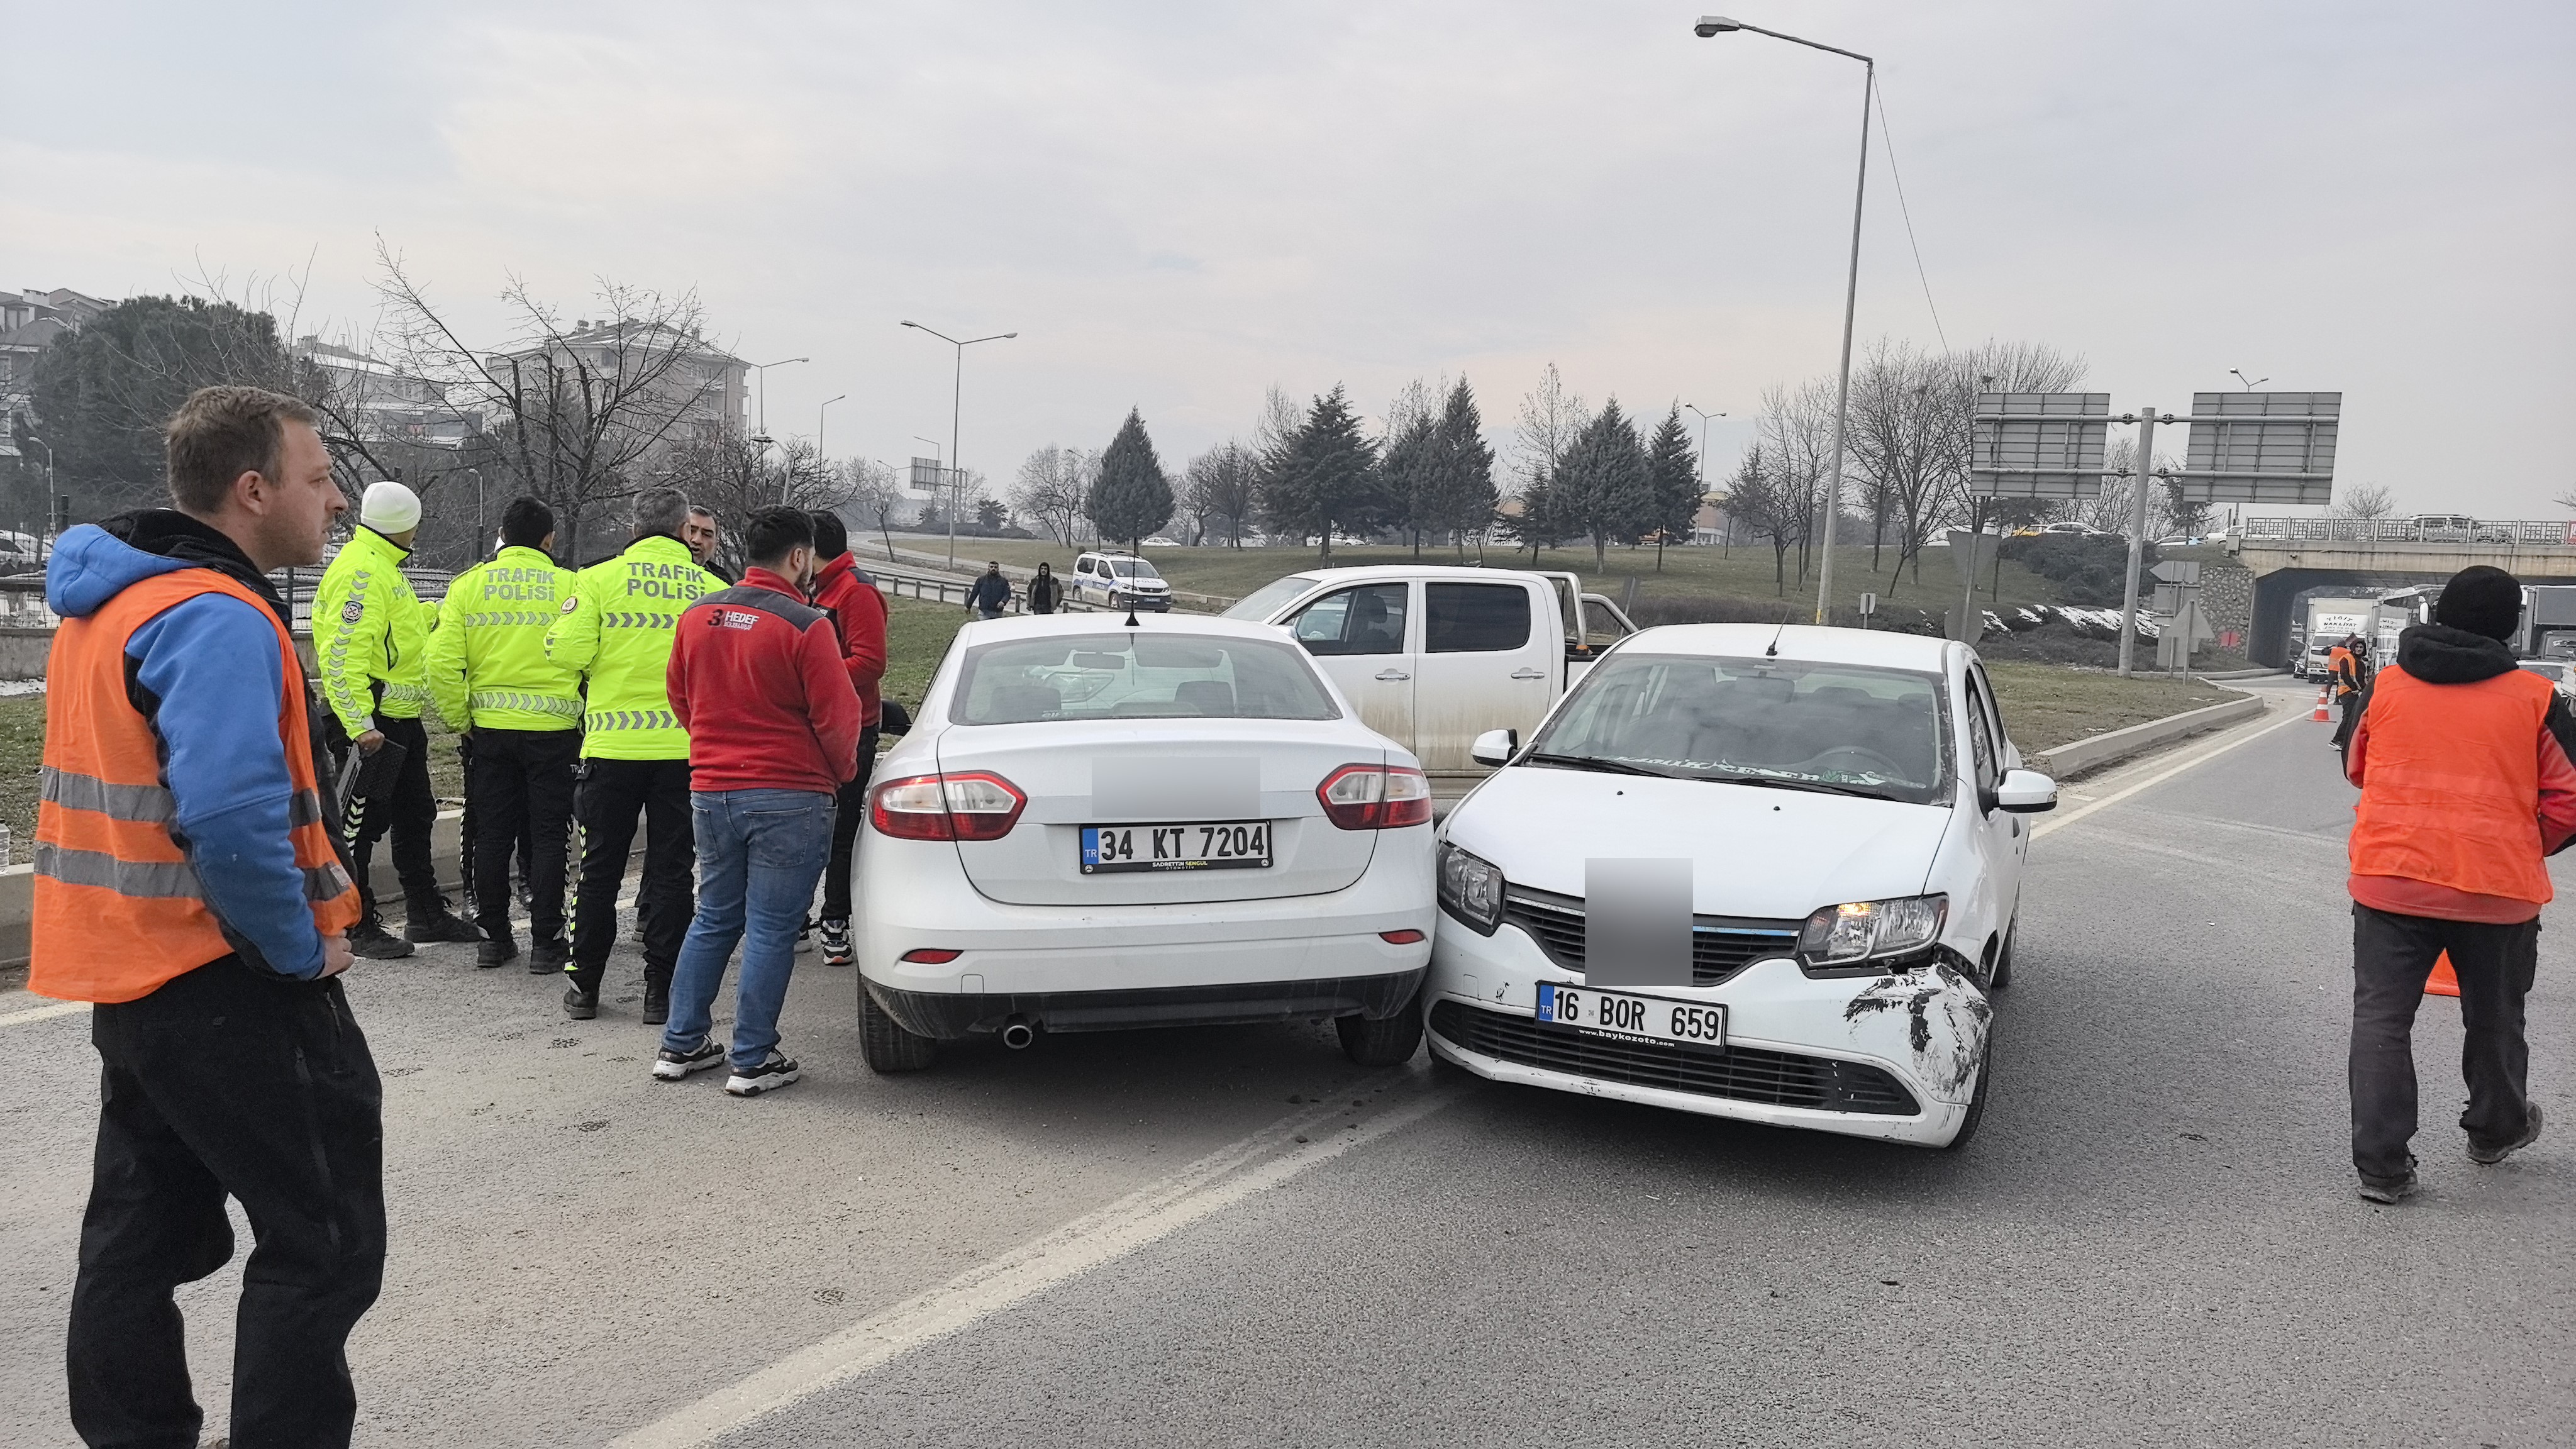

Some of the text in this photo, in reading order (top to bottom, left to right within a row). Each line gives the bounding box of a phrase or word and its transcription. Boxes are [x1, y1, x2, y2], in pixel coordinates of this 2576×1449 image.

[724, 611, 760, 625] HEDEF
[1085, 826, 1264, 860] TR 34 KT 7204
[1541, 991, 1719, 1040] TR 16 BOR 659
[1579, 1028, 1675, 1047] www.baykozoto.com
